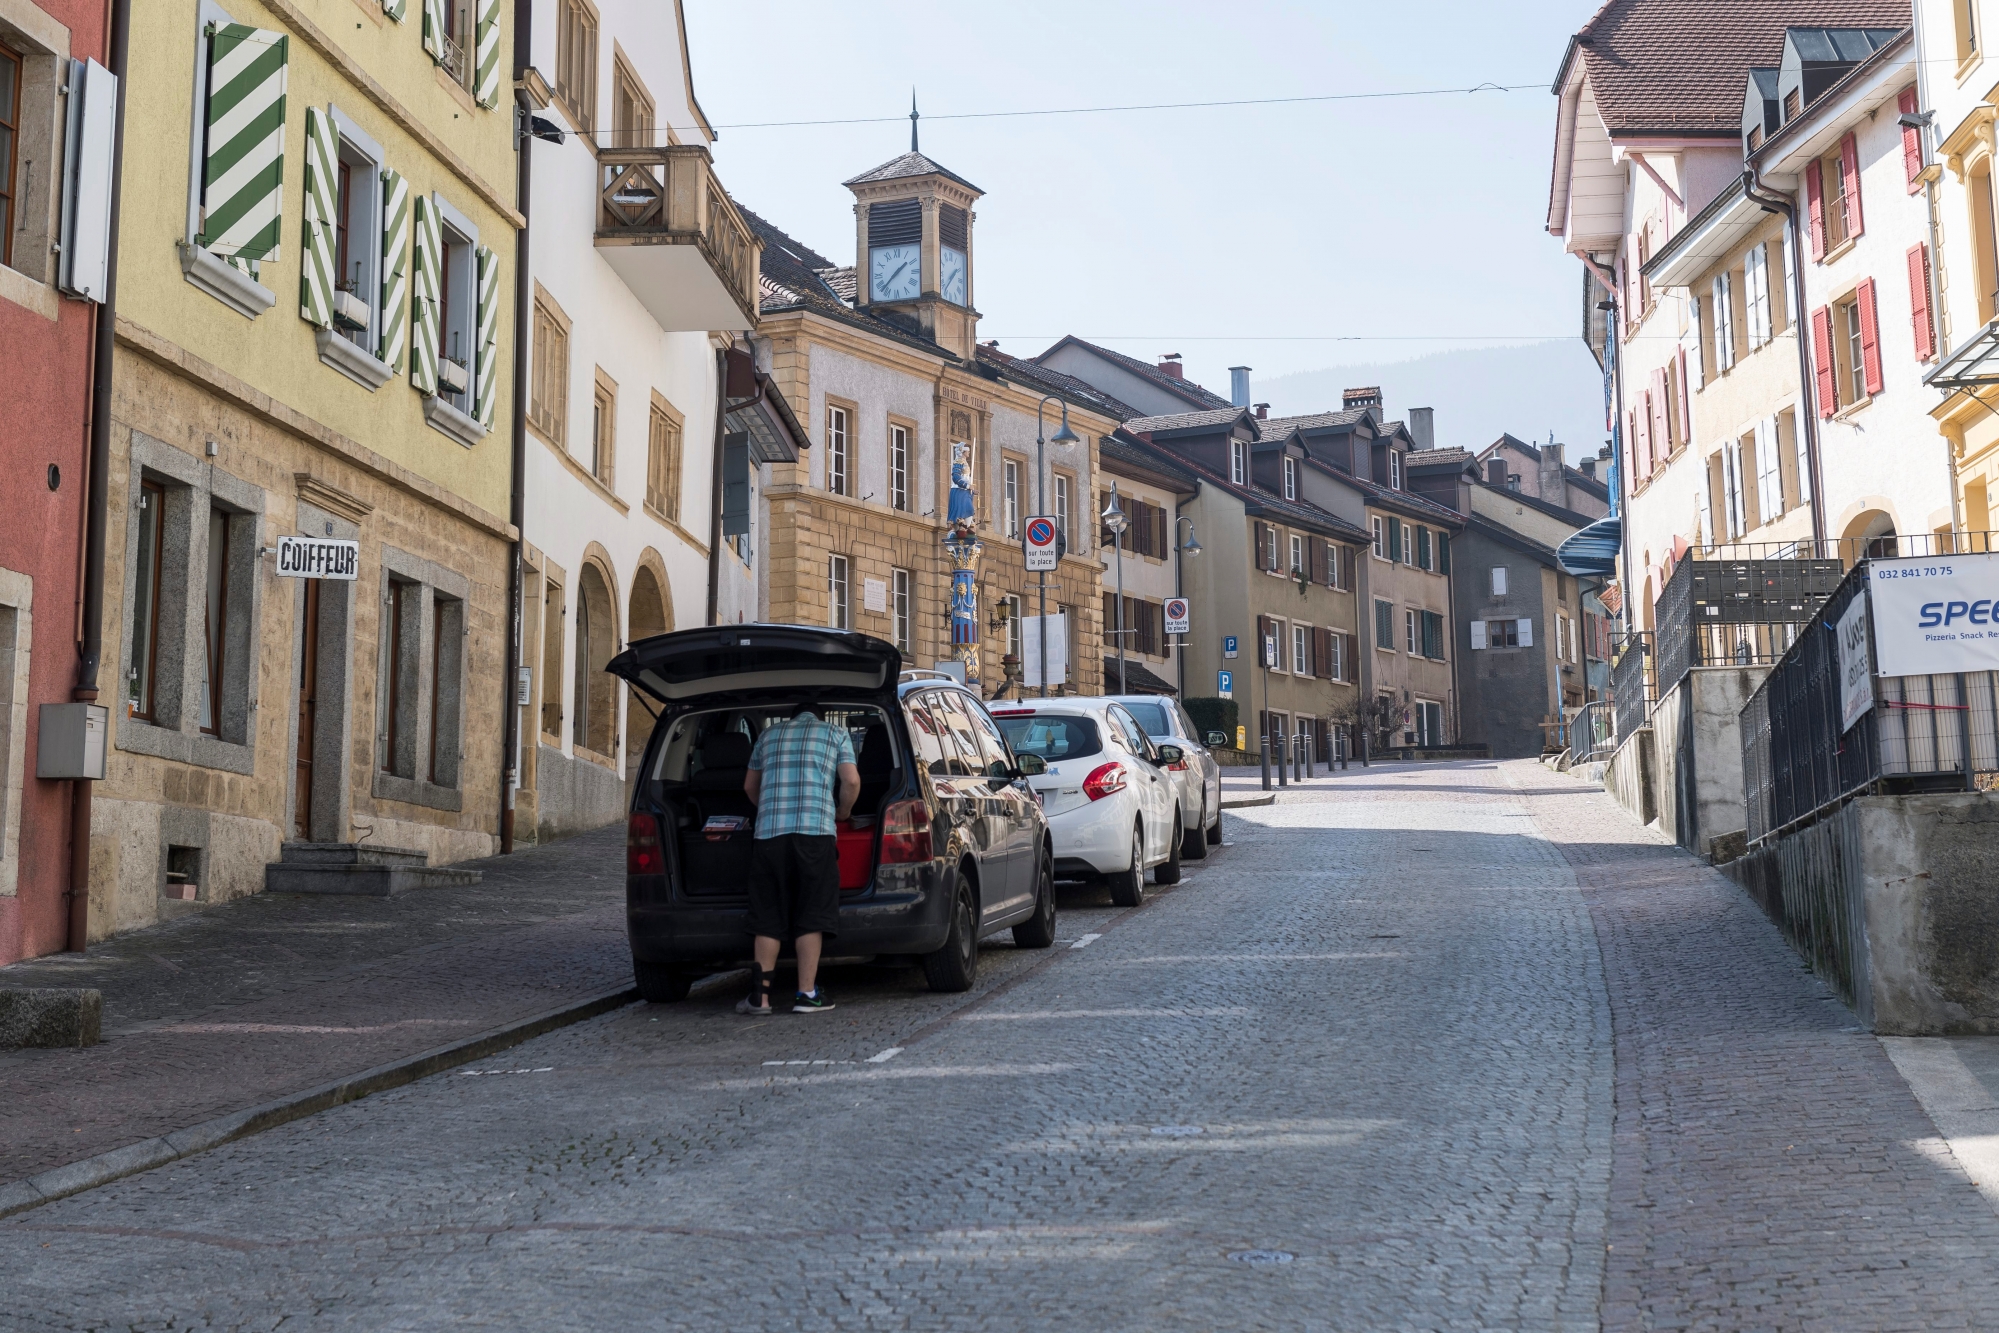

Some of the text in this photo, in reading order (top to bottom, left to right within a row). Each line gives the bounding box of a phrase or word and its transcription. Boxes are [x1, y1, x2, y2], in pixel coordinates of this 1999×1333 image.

[971, 396, 987, 410] VILLE
[1038, 558, 1052, 566] place
[1879, 566, 1953, 579] 032 841 70 75
[1925, 633, 1956, 641] Pizzeria
[1960, 631, 1984, 640] Snack
[1228, 639, 1234, 650] P
[1222, 674, 1229, 690] P
